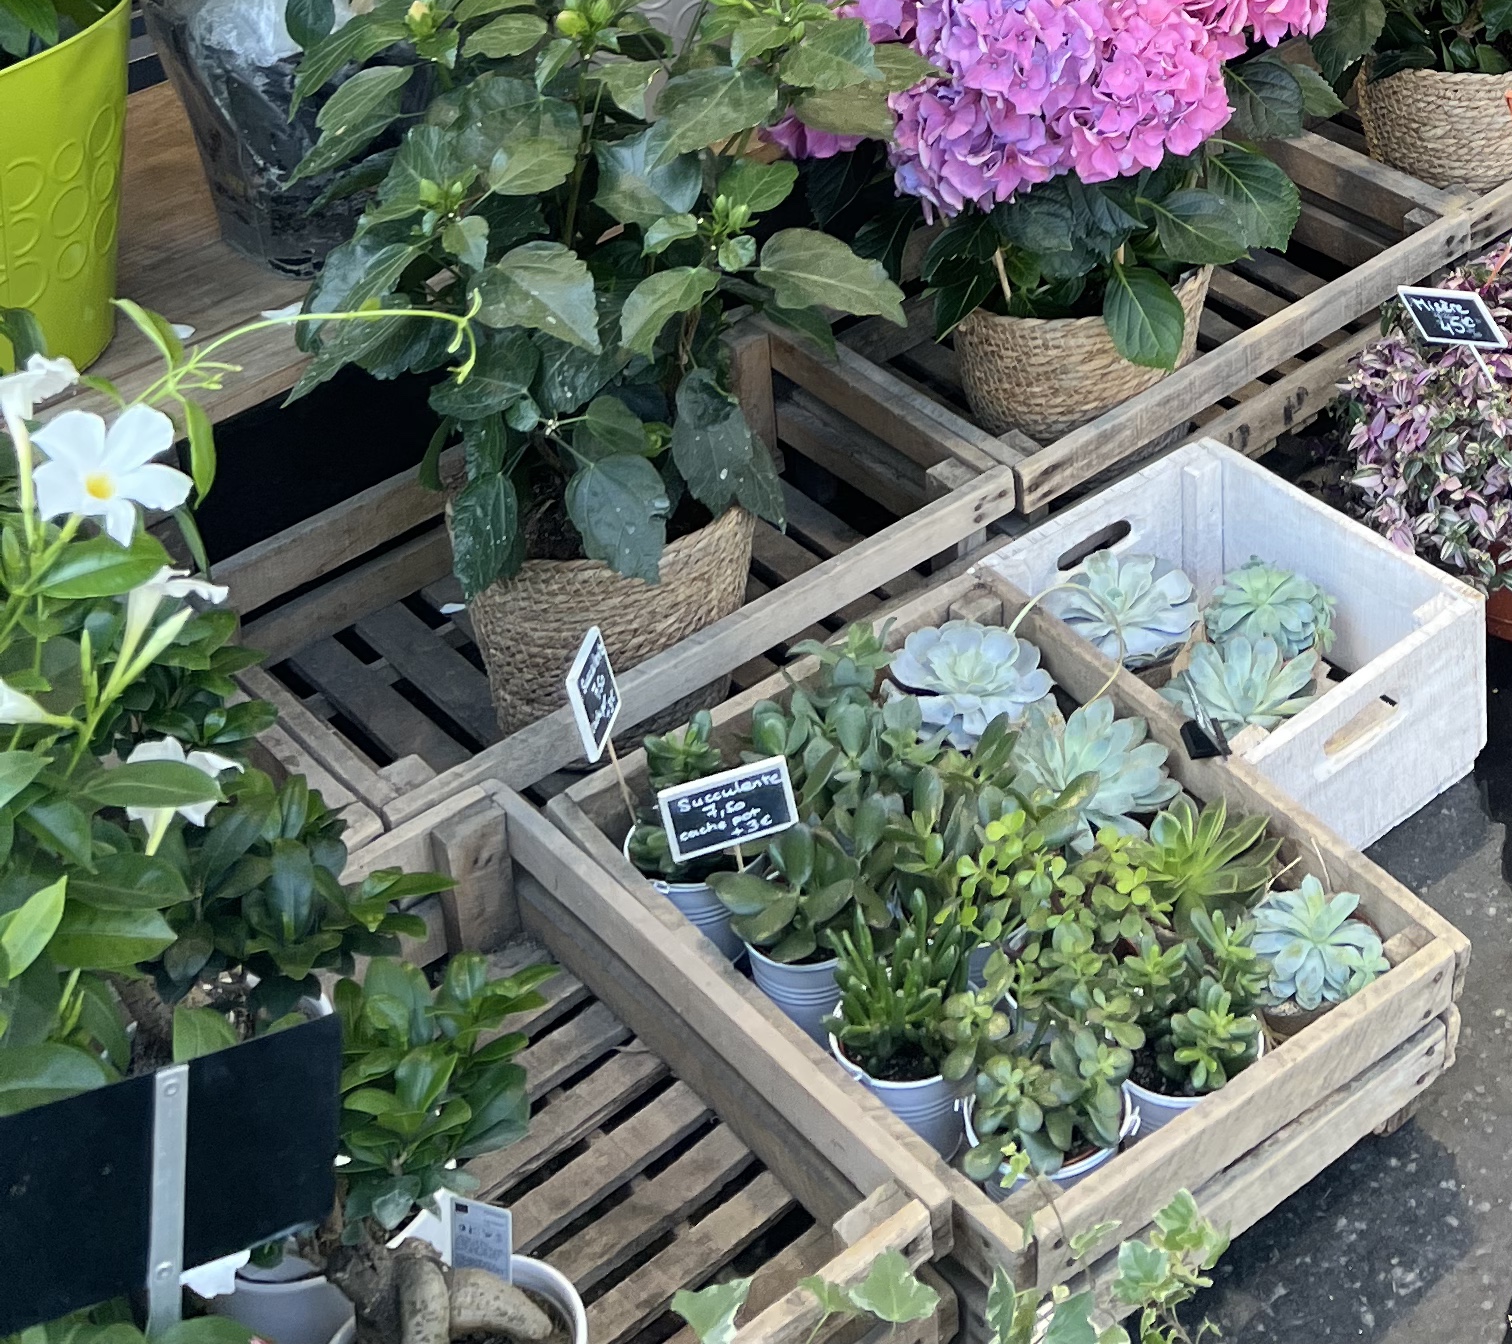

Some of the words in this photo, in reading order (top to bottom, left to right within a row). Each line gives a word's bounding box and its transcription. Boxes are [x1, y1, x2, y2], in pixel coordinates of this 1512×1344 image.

[676, 771, 783, 813] Succulente
[702, 800, 746, 819] 7,50
[679, 820, 727, 842] cache
[731, 807, 762, 827] pot
